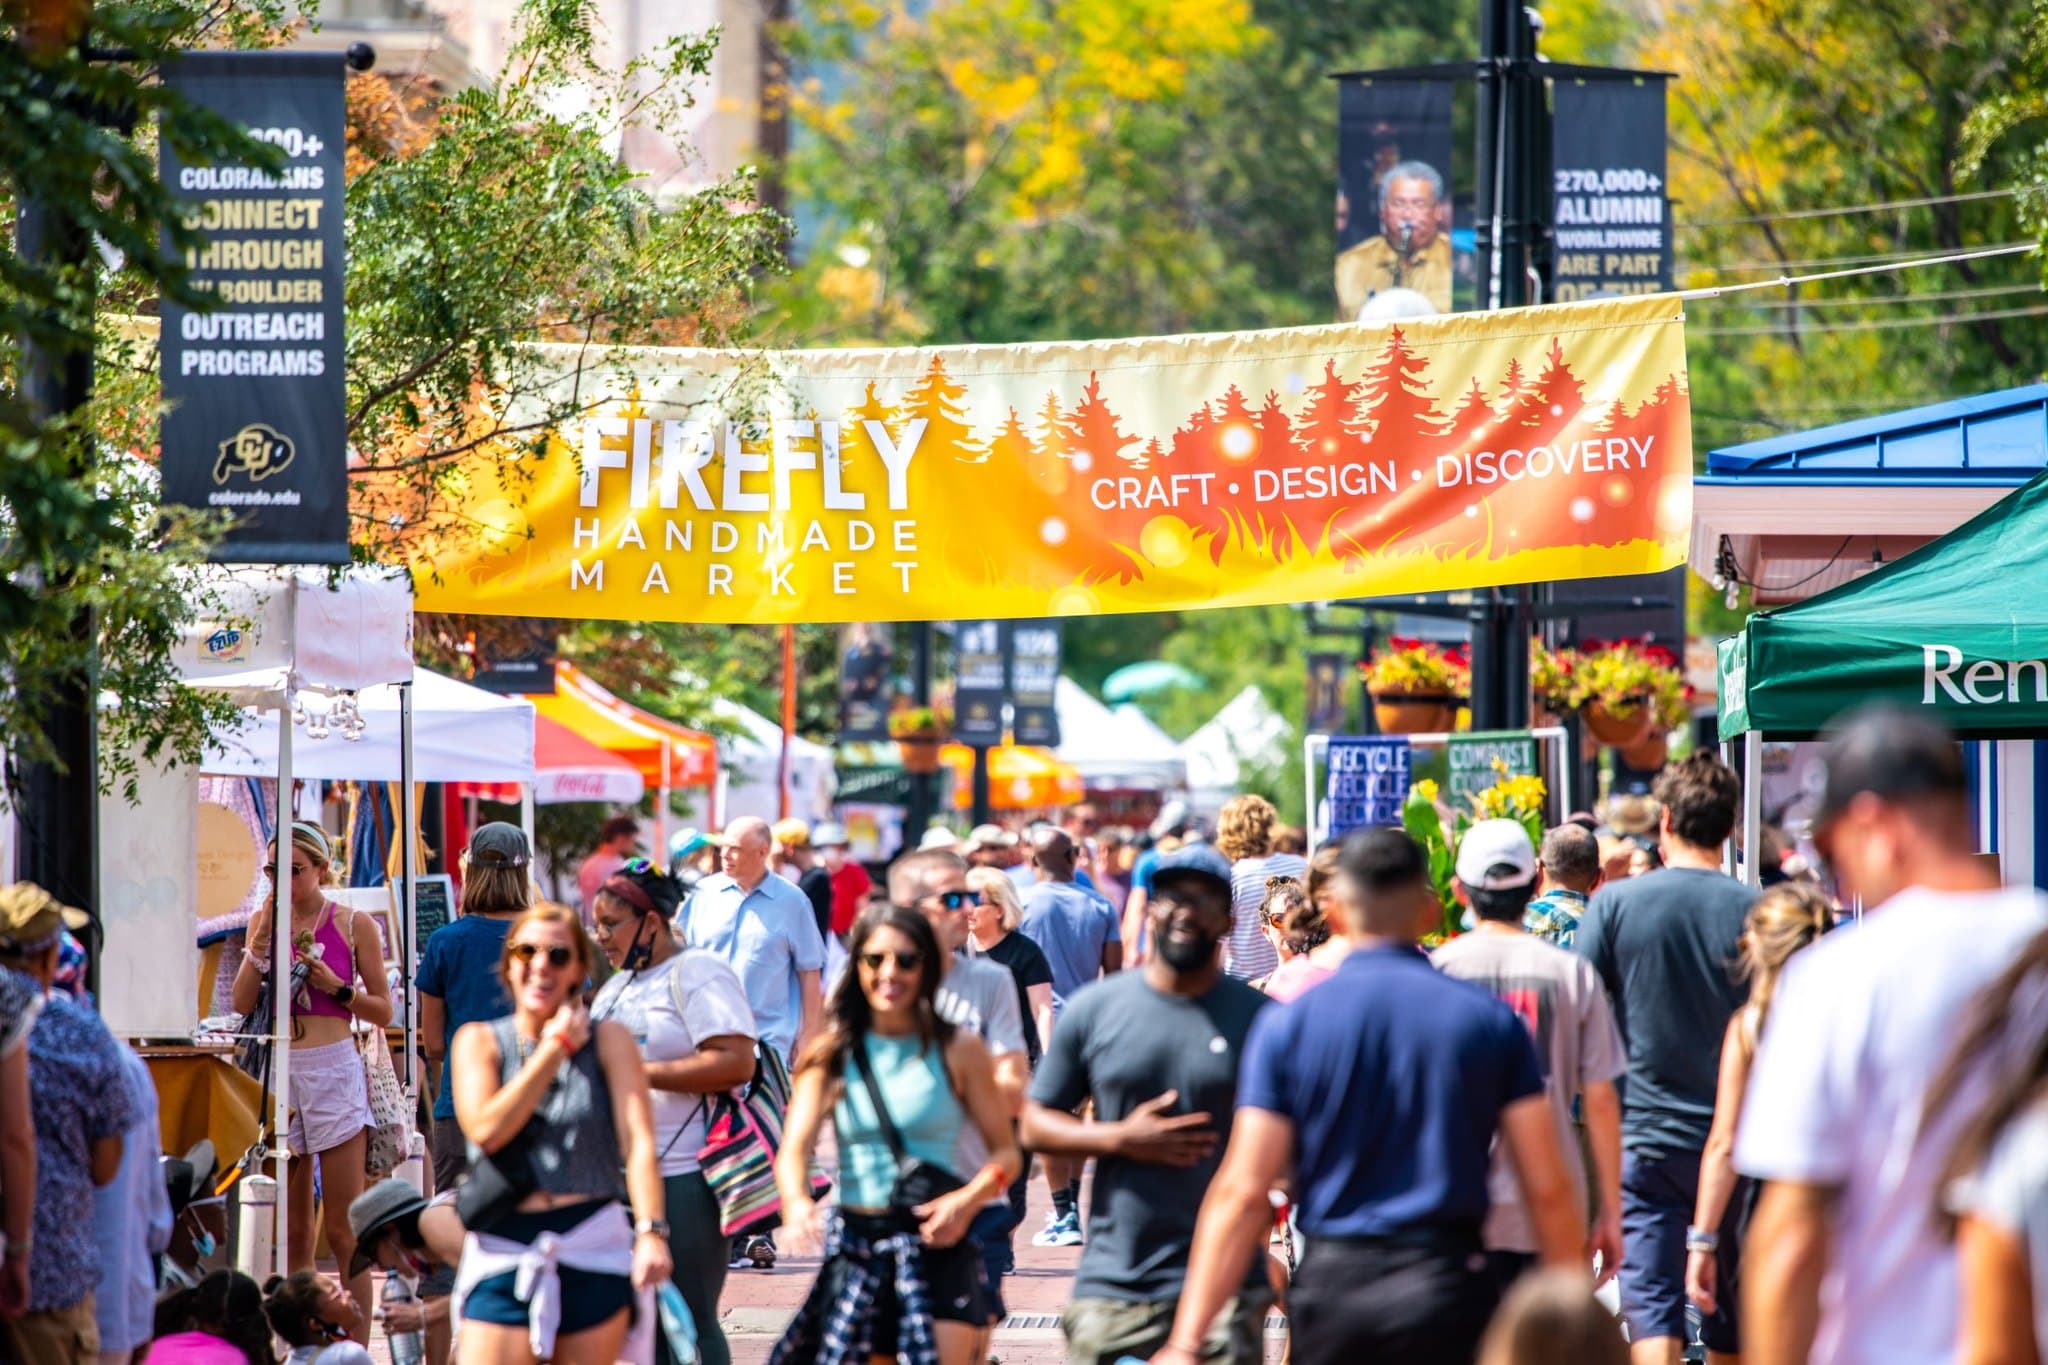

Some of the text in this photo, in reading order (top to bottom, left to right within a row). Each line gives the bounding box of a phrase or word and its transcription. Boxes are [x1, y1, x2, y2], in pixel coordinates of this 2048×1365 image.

[1555, 169, 1661, 195] 270,000+
[1556, 197, 1662, 224] ALUMNI
[1556, 229, 1662, 249] WORLDWIDE
[1556, 253, 1661, 276] ARE PART
[218, 279, 324, 303] BOULDER
[181, 312, 325, 341] OUTREACH
[181, 349, 325, 376] PROGRAMS
[579, 416, 929, 513] FIREFLY
[1090, 434, 1655, 511] CRAFT DESIGN DISCOVERY
[208, 488, 300, 506] colorado.edu
[573, 517, 918, 554] HANDMADE
[570, 559, 918, 596] MARKET
[1329, 746, 1409, 773] RECYCLE
